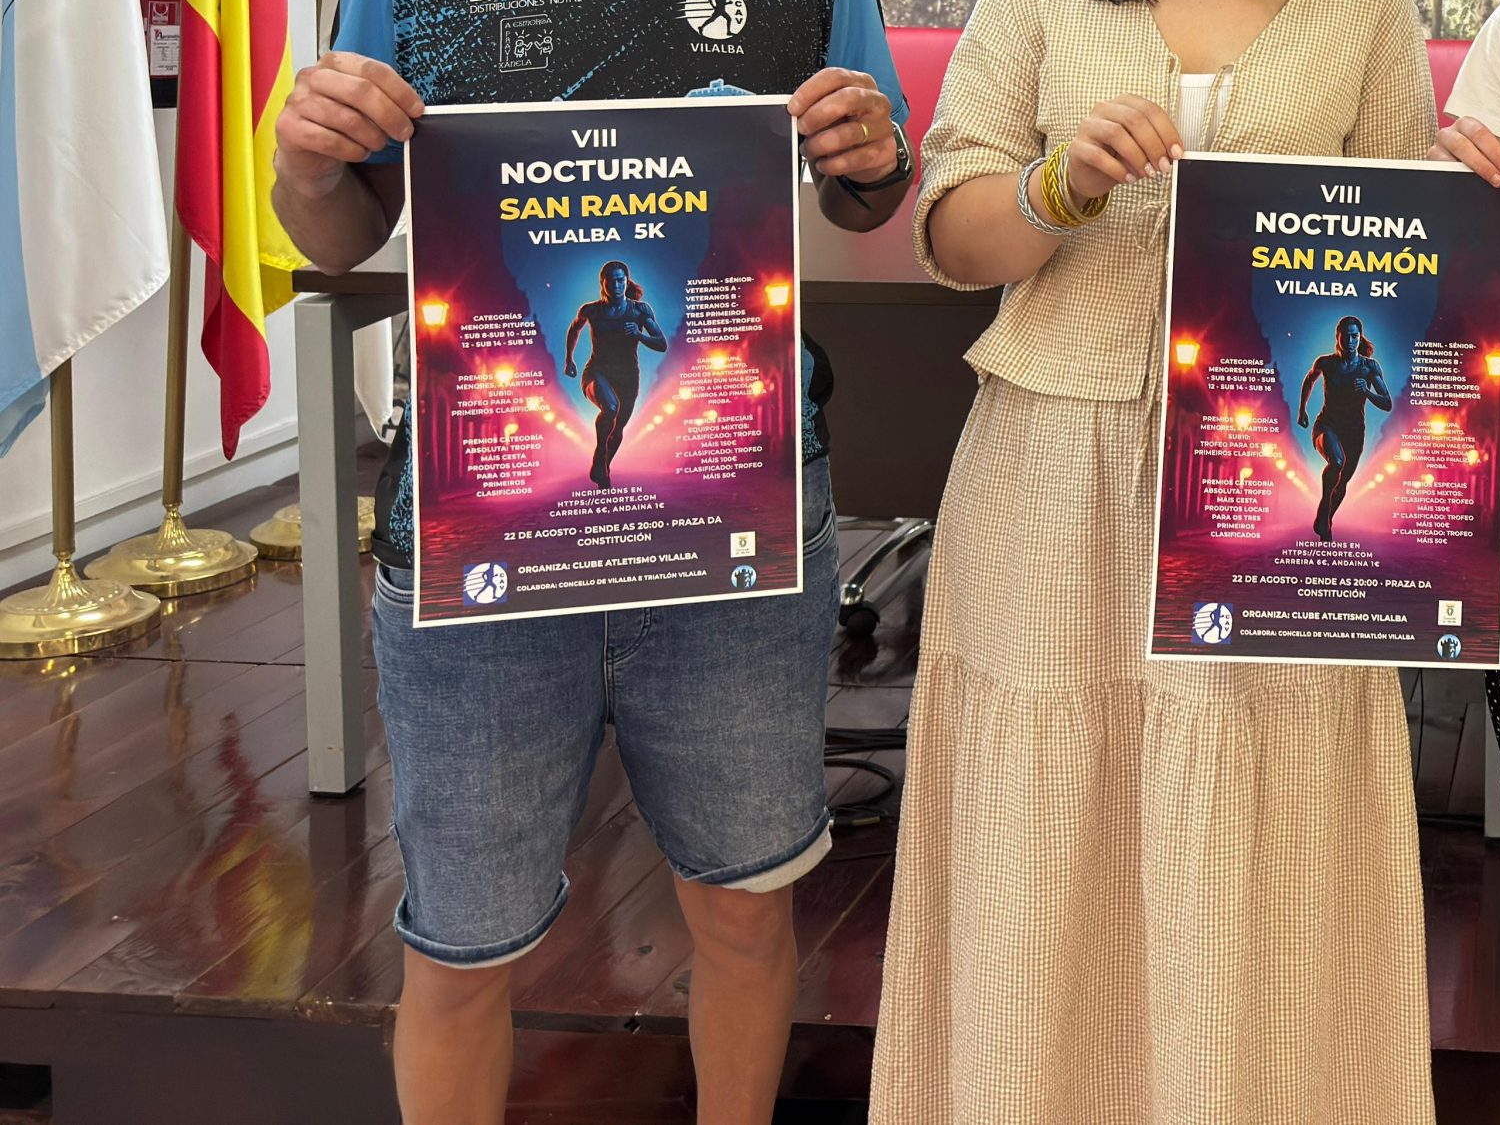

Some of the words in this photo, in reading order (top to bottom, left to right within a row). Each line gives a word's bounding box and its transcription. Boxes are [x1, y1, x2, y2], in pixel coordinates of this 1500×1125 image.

[690, 42, 744, 54] VILALBA
[571, 128, 616, 148] VIII
[501, 156, 694, 184] NOCTURNA
[1320, 184, 1360, 204] VIII
[500, 196, 570, 220] SAN
[581, 186, 707, 217] RAMÓN
[1255, 211, 1428, 239] NOCTURNA
[527, 227, 621, 244] VILALBA
[634, 222, 665, 239] 5K
[1251, 246, 1314, 270] SAN
[1324, 246, 1438, 275] RAMÓN
[685, 285, 730, 294] VETERANOS
[1275, 279, 1358, 297] VILALBA
[1369, 281, 1398, 297] 5K
[685, 293, 730, 302] VETERANOS
[473, 312, 522, 321] CATEGORÍAS
[705, 309, 746, 317] PRIMEIROS
[685, 316, 761, 326] VILALBESES-TROFEO
[686, 334, 739, 343] CLASIFICADOS
[480, 454, 500, 462] MÁIS
[467, 462, 510, 472] PRODUTOS
[482, 479, 525, 488] PRIMEIROS
[476, 487, 532, 497] CLASIFICADOS
[549, 507, 593, 517] CARREIRA
[612, 503, 652, 512] ANDAINA
[504, 532, 516, 540] 22
[518, 530, 532, 539] DE
[534, 527, 577, 538] AGOSTO
[584, 523, 620, 534] DENDE
[621, 522, 635, 531] AS
[637, 520, 664, 530] 20:00
[671, 517, 705, 527] PRAZA
[707, 515, 722, 524] DA
[576, 532, 651, 546] CONSTITUCIÓN
[517, 562, 570, 574] ORGANIZA:
[572, 559, 603, 569] CLUBE
[604, 555, 657, 566] ATLETISMO
[658, 552, 698, 562] VILALBA
[516, 582, 557, 592] COLABORA:
[558, 579, 595, 588] CONCELLO
[607, 575, 637, 584] VILALBA
[643, 571, 677, 580] TRIATLÓN
[678, 569, 707, 578] VILALBA
[1232, 574, 1242, 582] 22
[1244, 575, 1258, 583] DE
[1259, 575, 1298, 584] AGOSTO
[1304, 576, 1337, 585] DENDE
[1339, 578, 1352, 586] AS
[1353, 578, 1378, 587] 20:00
[1385, 579, 1416, 588] PRAZA
[1418, 580, 1432, 588] DA
[1297, 588, 1366, 598] CONSTITUCIÓN
[1242, 610, 1290, 618] ORGANIZA:
[1291, 611, 1320, 620] CLUBE
[1321, 612, 1369, 621] ATLETISMO
[1370, 613, 1407, 622] VILALBA
